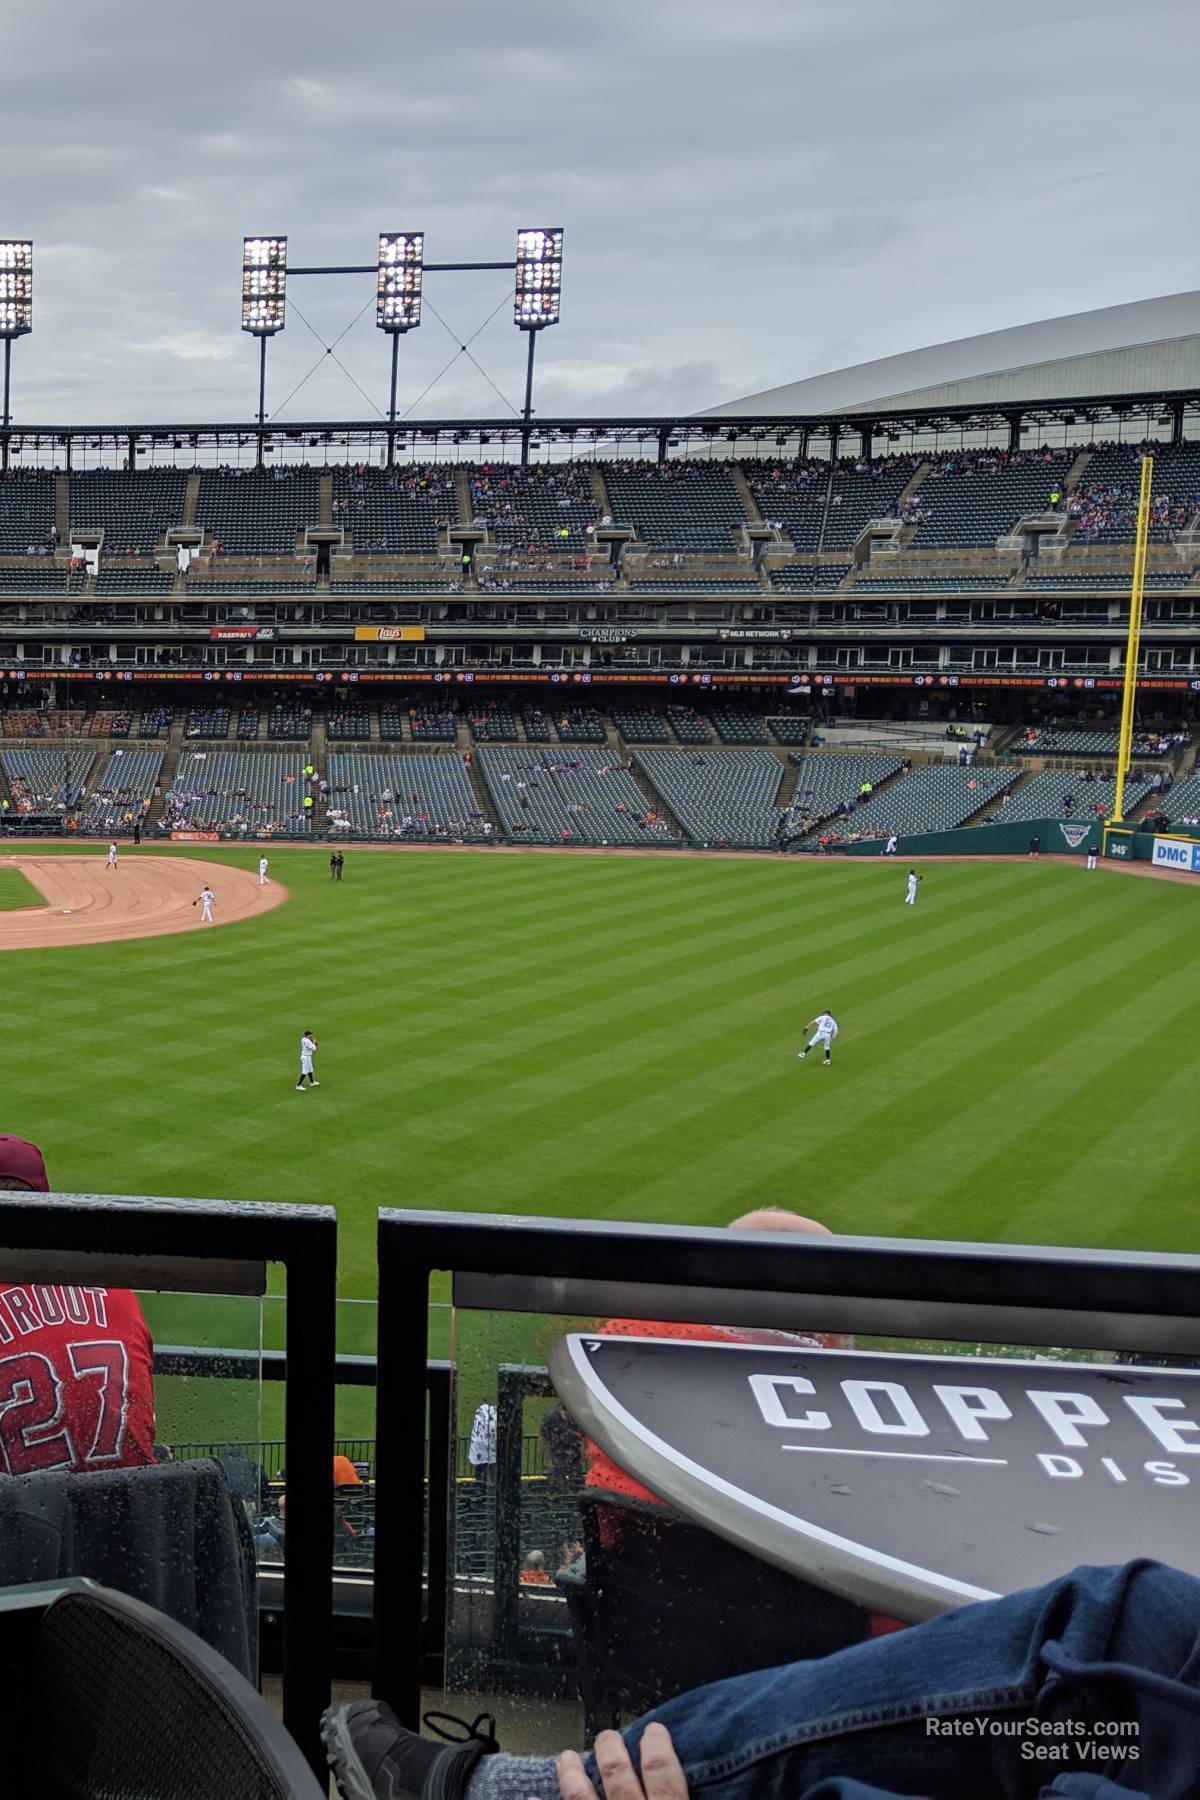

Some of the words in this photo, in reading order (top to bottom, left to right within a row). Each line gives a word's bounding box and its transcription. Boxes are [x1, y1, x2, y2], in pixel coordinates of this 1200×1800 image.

[580, 628, 638, 637] CHAMPIONS
[1156, 845, 1188, 863] DMC
[748, 1374, 1200, 1453] COPPE
[1036, 1453, 1190, 1486] DIS
